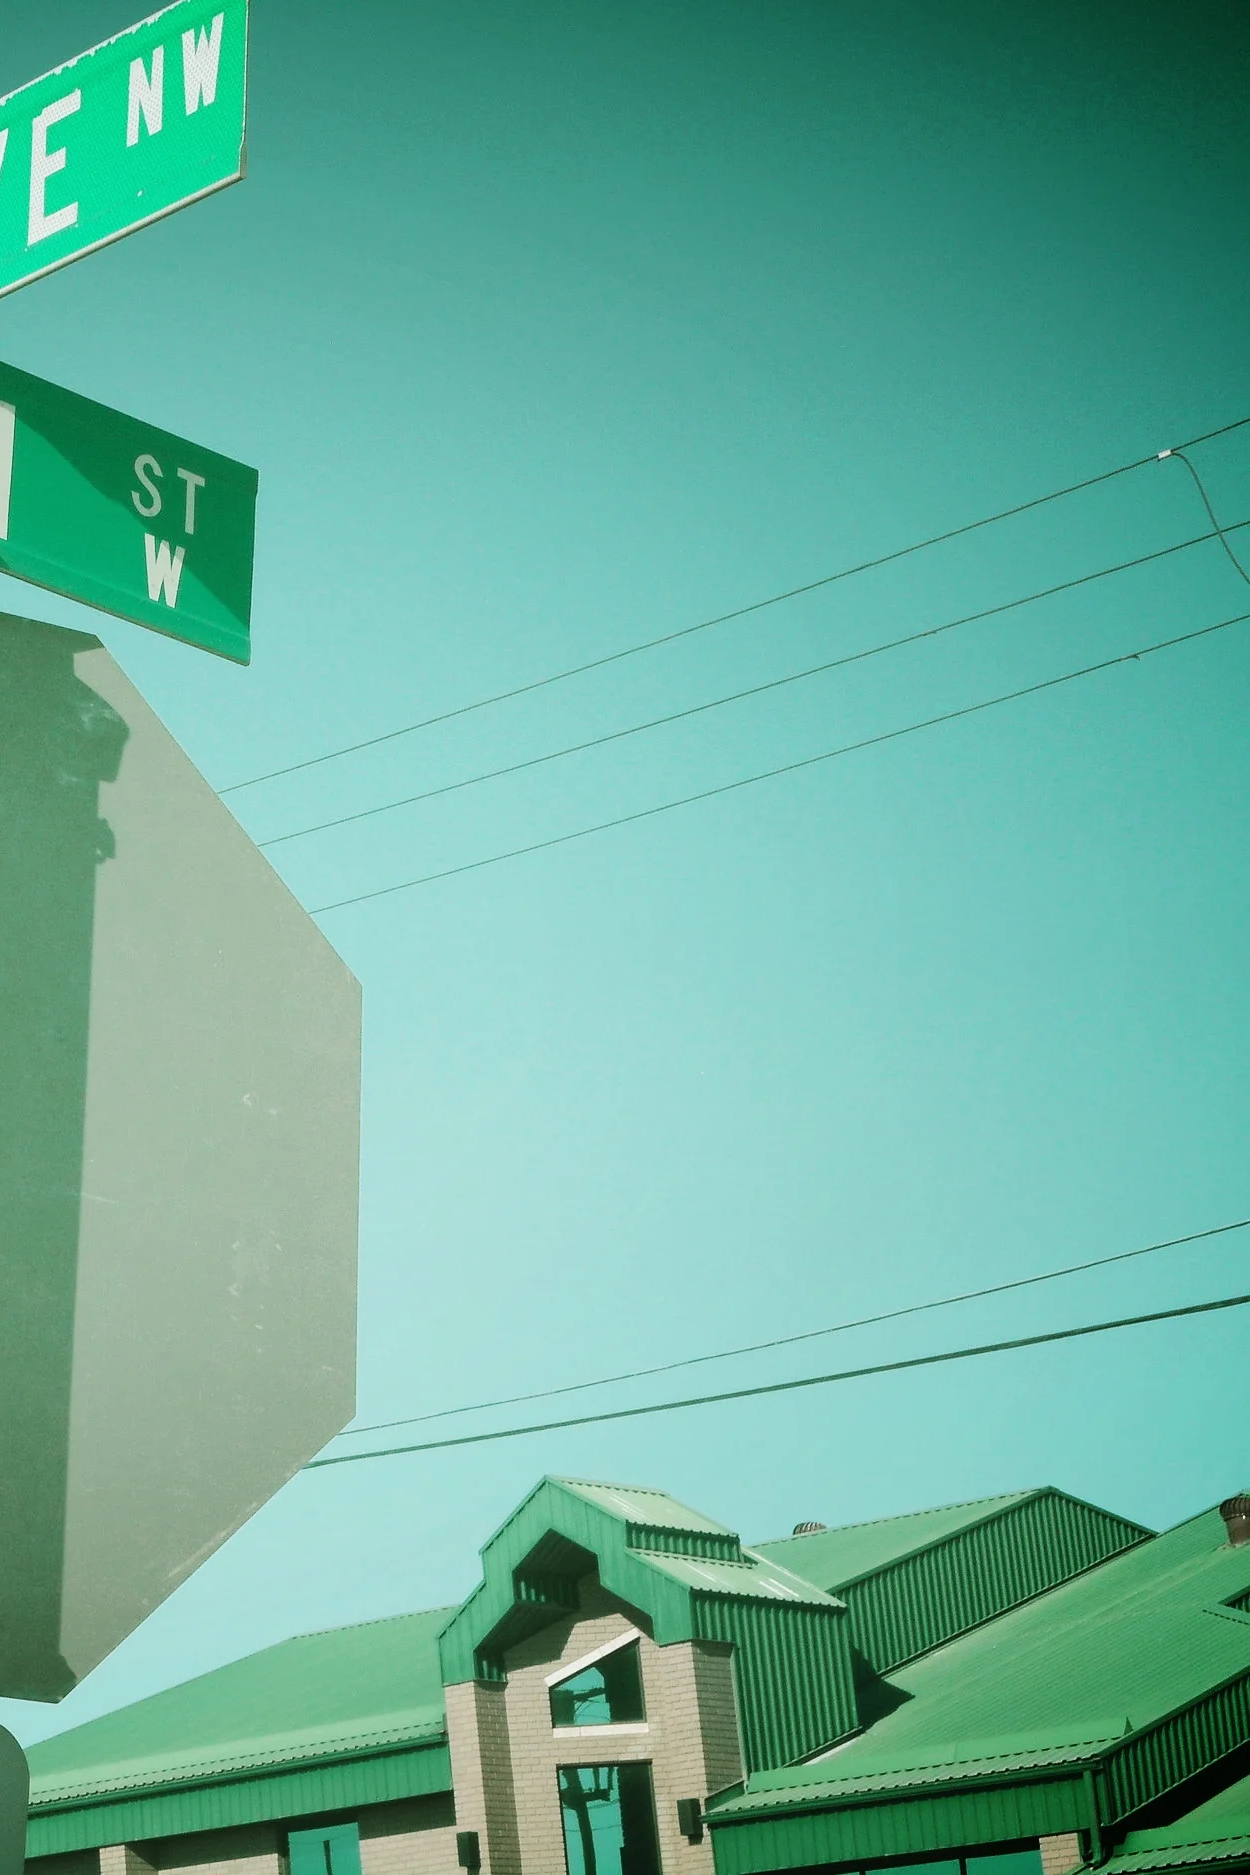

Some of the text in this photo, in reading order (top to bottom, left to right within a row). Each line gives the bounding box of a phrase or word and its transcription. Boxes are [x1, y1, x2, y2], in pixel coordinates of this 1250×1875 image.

[127, 12, 224, 146] NW
[131, 454, 205, 535] ST
[143, 533, 185, 608] W
